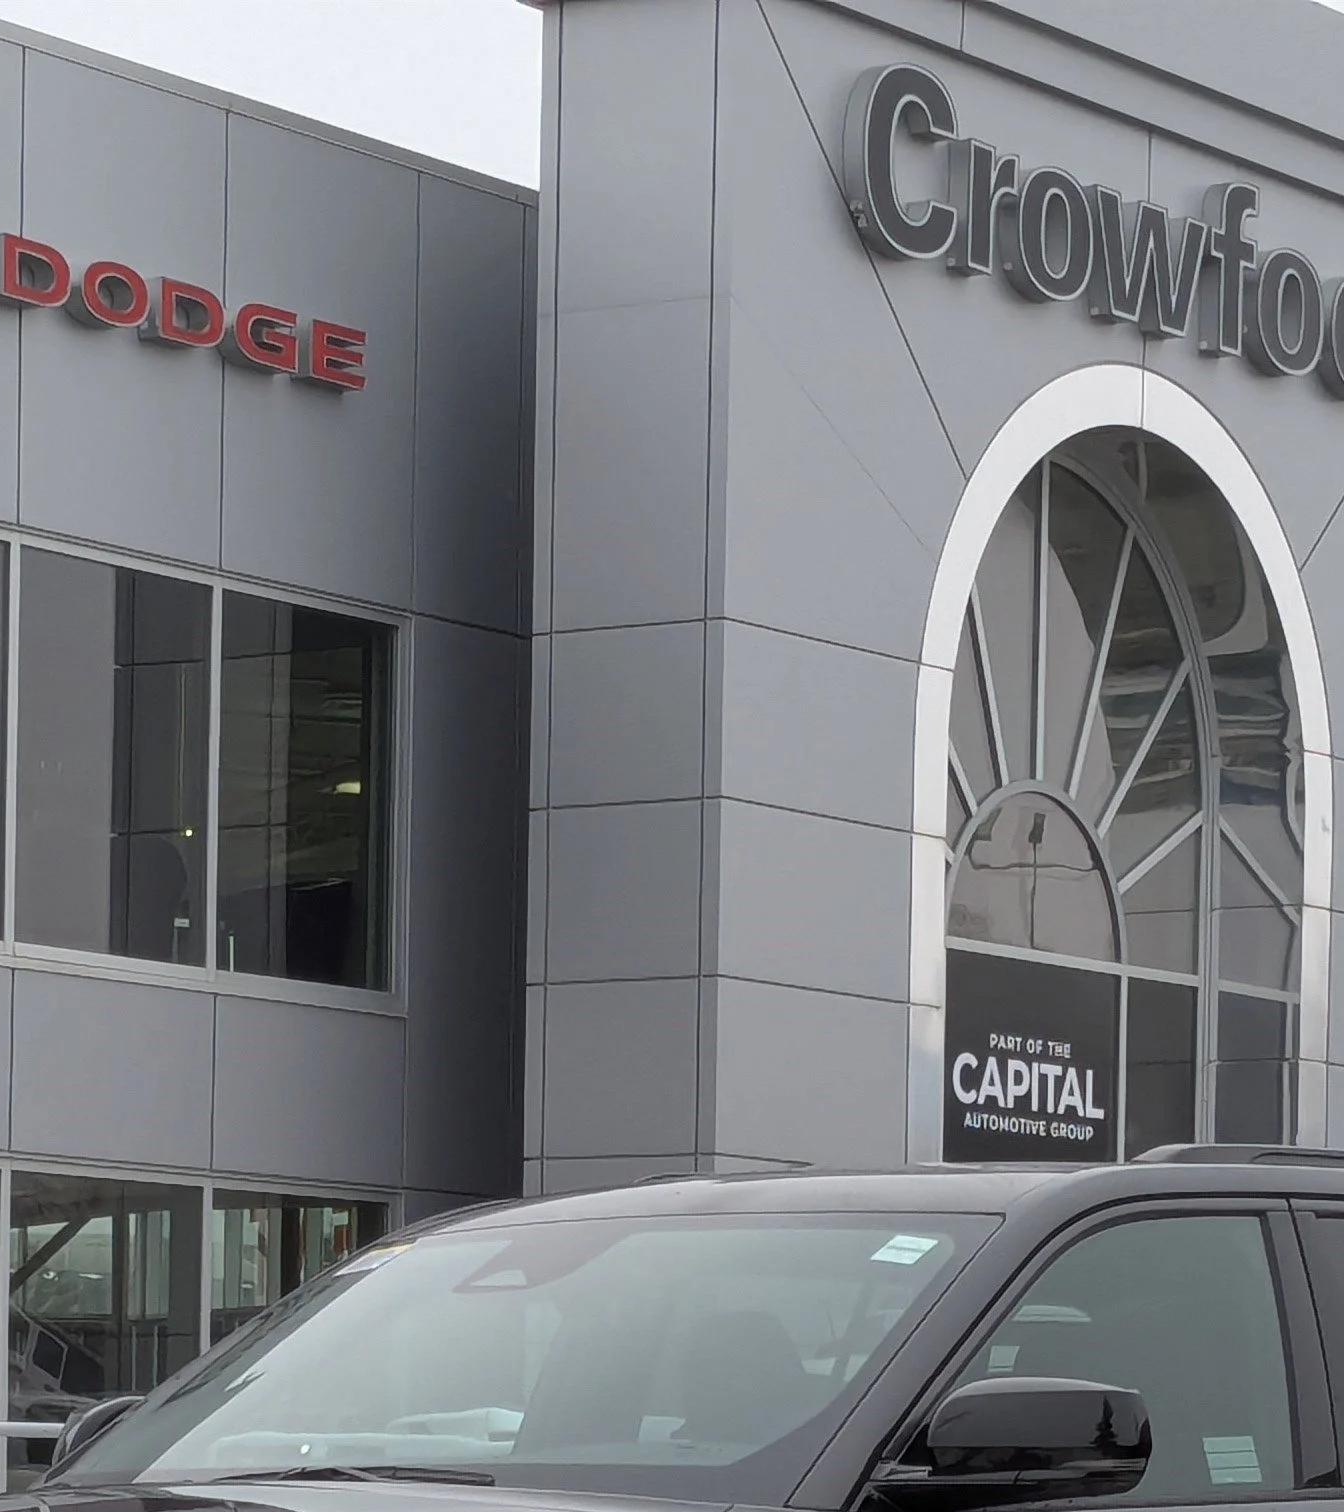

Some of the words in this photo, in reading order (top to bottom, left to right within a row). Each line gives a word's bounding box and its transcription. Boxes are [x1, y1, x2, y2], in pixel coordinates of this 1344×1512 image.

[0, 233, 367, 391] DODGE
[989, 1033, 1022, 1052] PART
[1026, 1038, 1043, 1054] OF
[1048, 1041, 1072, 1058] THE
[952, 1052, 1105, 1120] CAPITAL
[963, 1111, 1047, 1137] AUTOMOTIVE
[1050, 1122, 1094, 1142] GROUP
